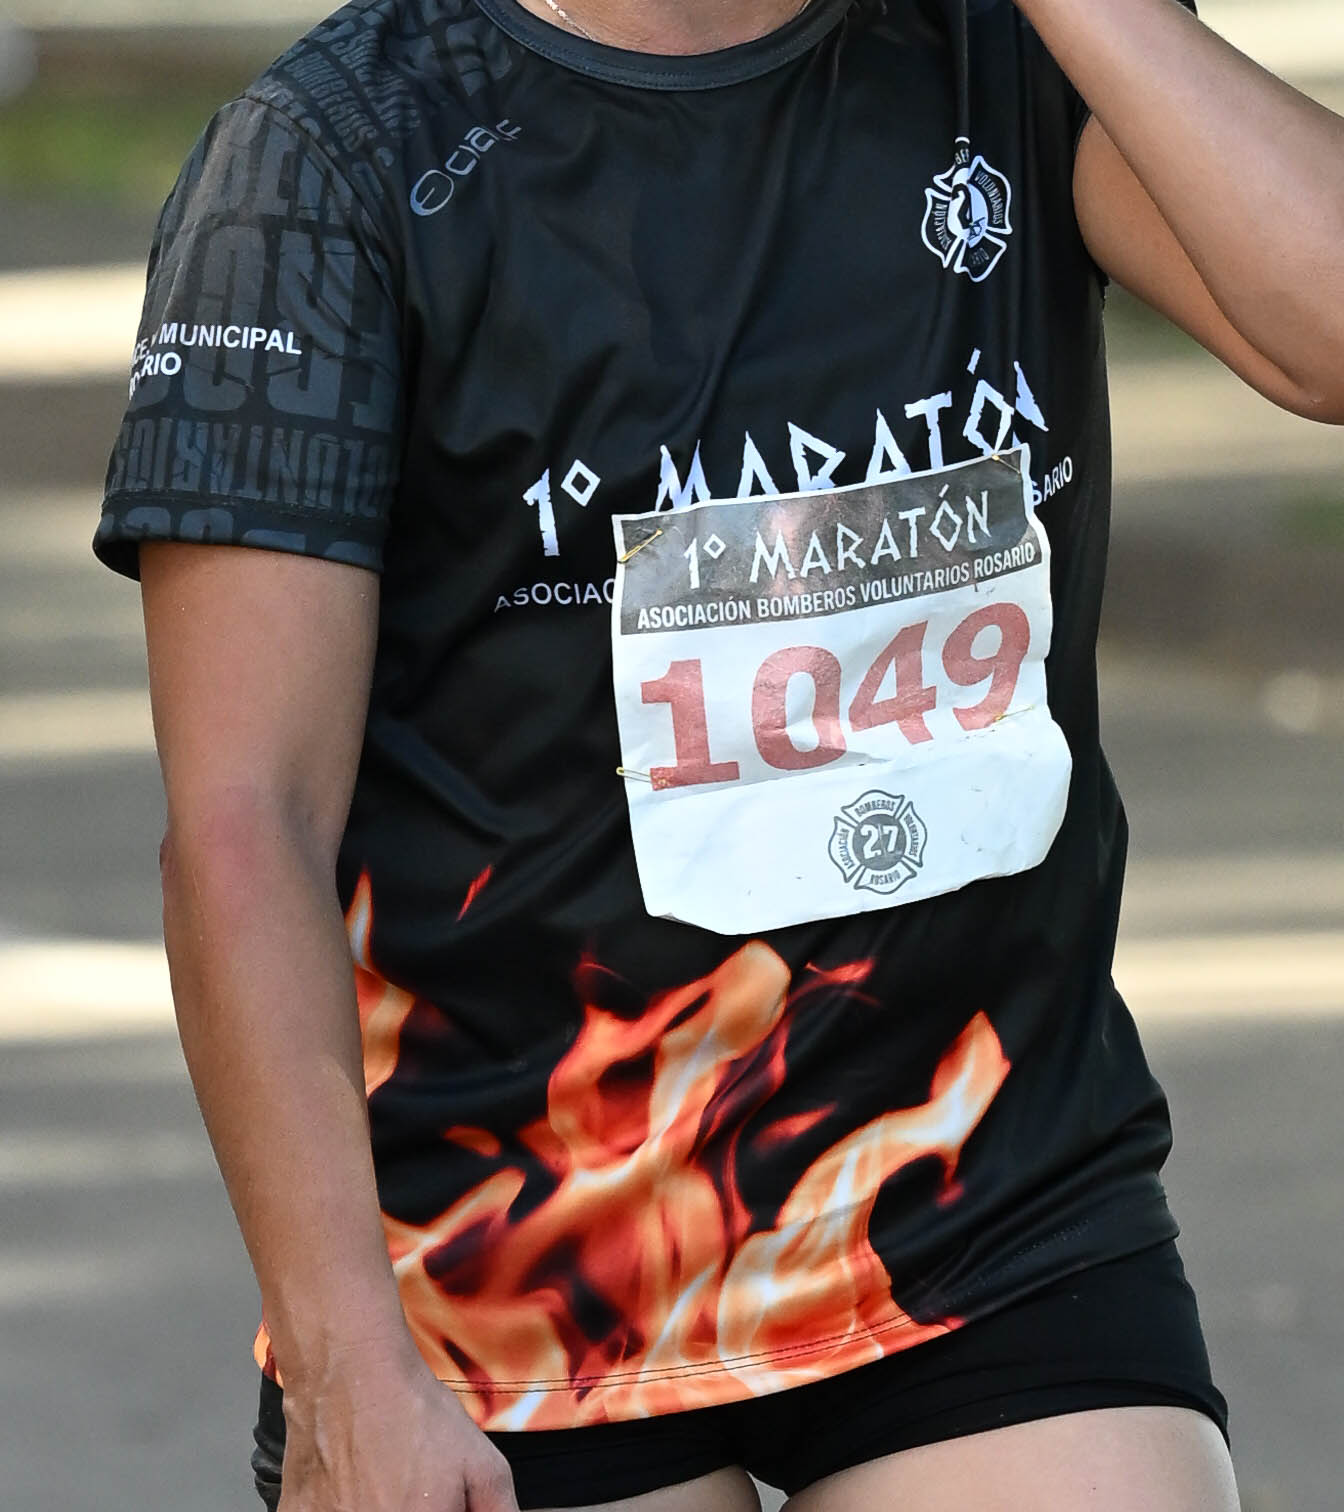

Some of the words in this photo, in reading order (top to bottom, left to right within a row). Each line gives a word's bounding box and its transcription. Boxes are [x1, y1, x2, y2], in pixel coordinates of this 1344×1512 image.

[158, 322, 303, 356] MUNICIPAL
[750, 483, 992, 583] MARATÓN
[636, 595, 752, 630] ASOCIACIÓN
[756, 586, 856, 618] BOMBEROS
[859, 562, 970, 604] VOLUNTARIOS
[973, 541, 1036, 579] ROSARIO
[640, 601, 1031, 792] 1049
[859, 823, 899, 860] 27
